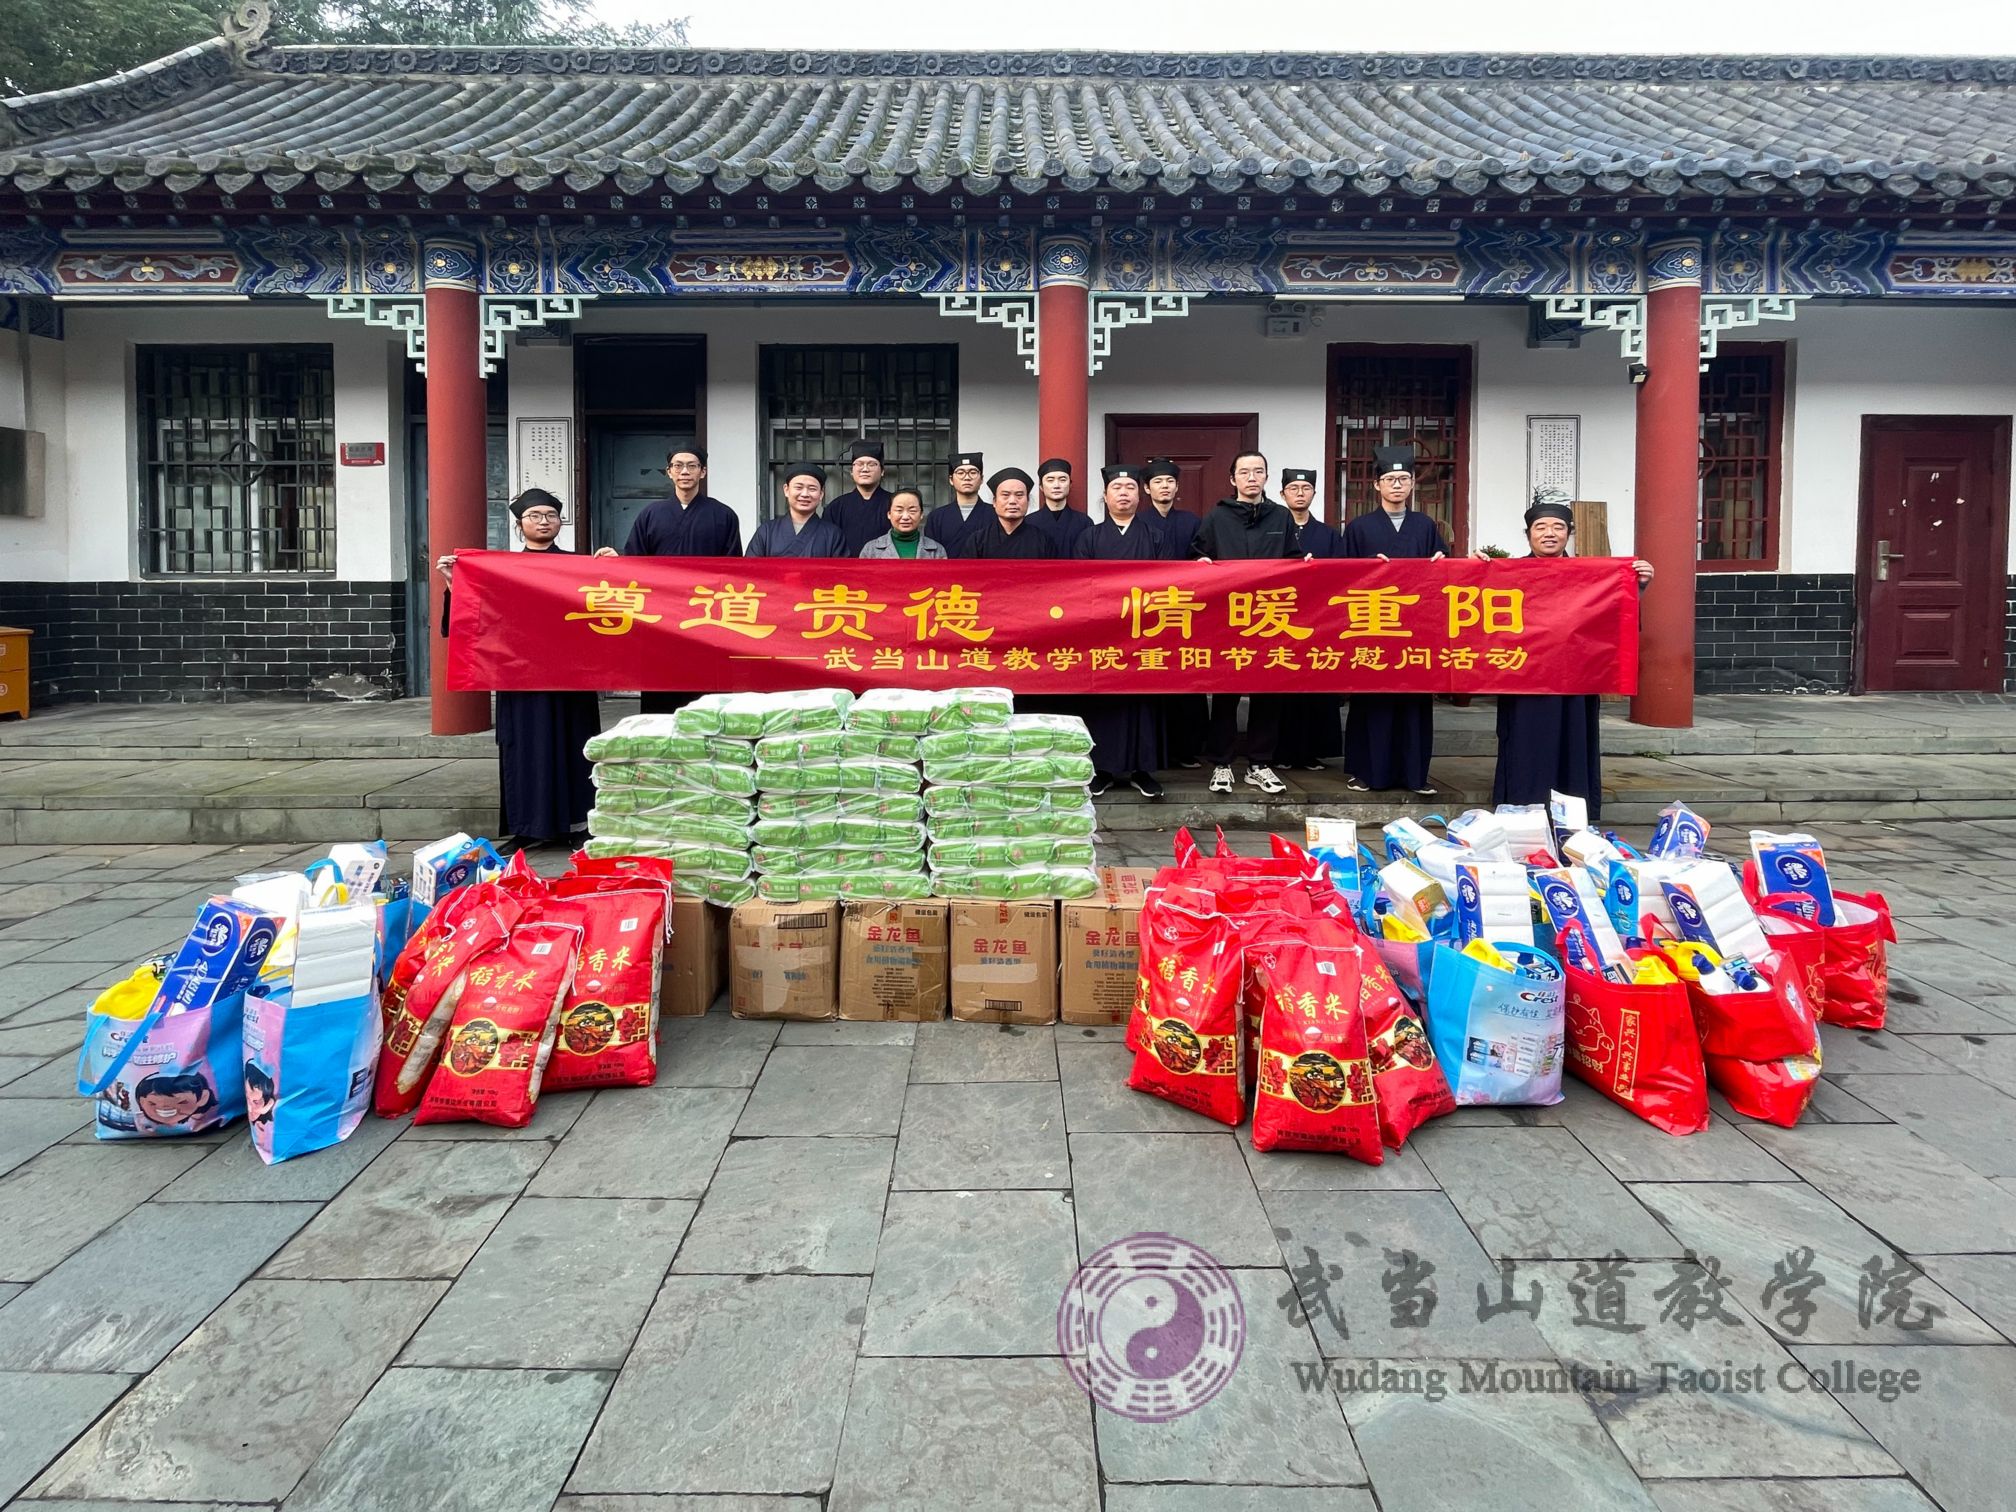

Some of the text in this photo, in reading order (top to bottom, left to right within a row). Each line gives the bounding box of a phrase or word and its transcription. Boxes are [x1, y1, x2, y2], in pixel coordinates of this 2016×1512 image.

[564, 581, 1525, 641] 尊道贵德·情暖重阳
[867, 925, 921, 943] 金龙鱼
[1086, 929, 1140, 946] 金龙鱼
[973, 938, 1027, 955] 金龙鱼
[470, 966, 538, 992] 稻香米
[1520, 992, 1559, 1004] Crest
